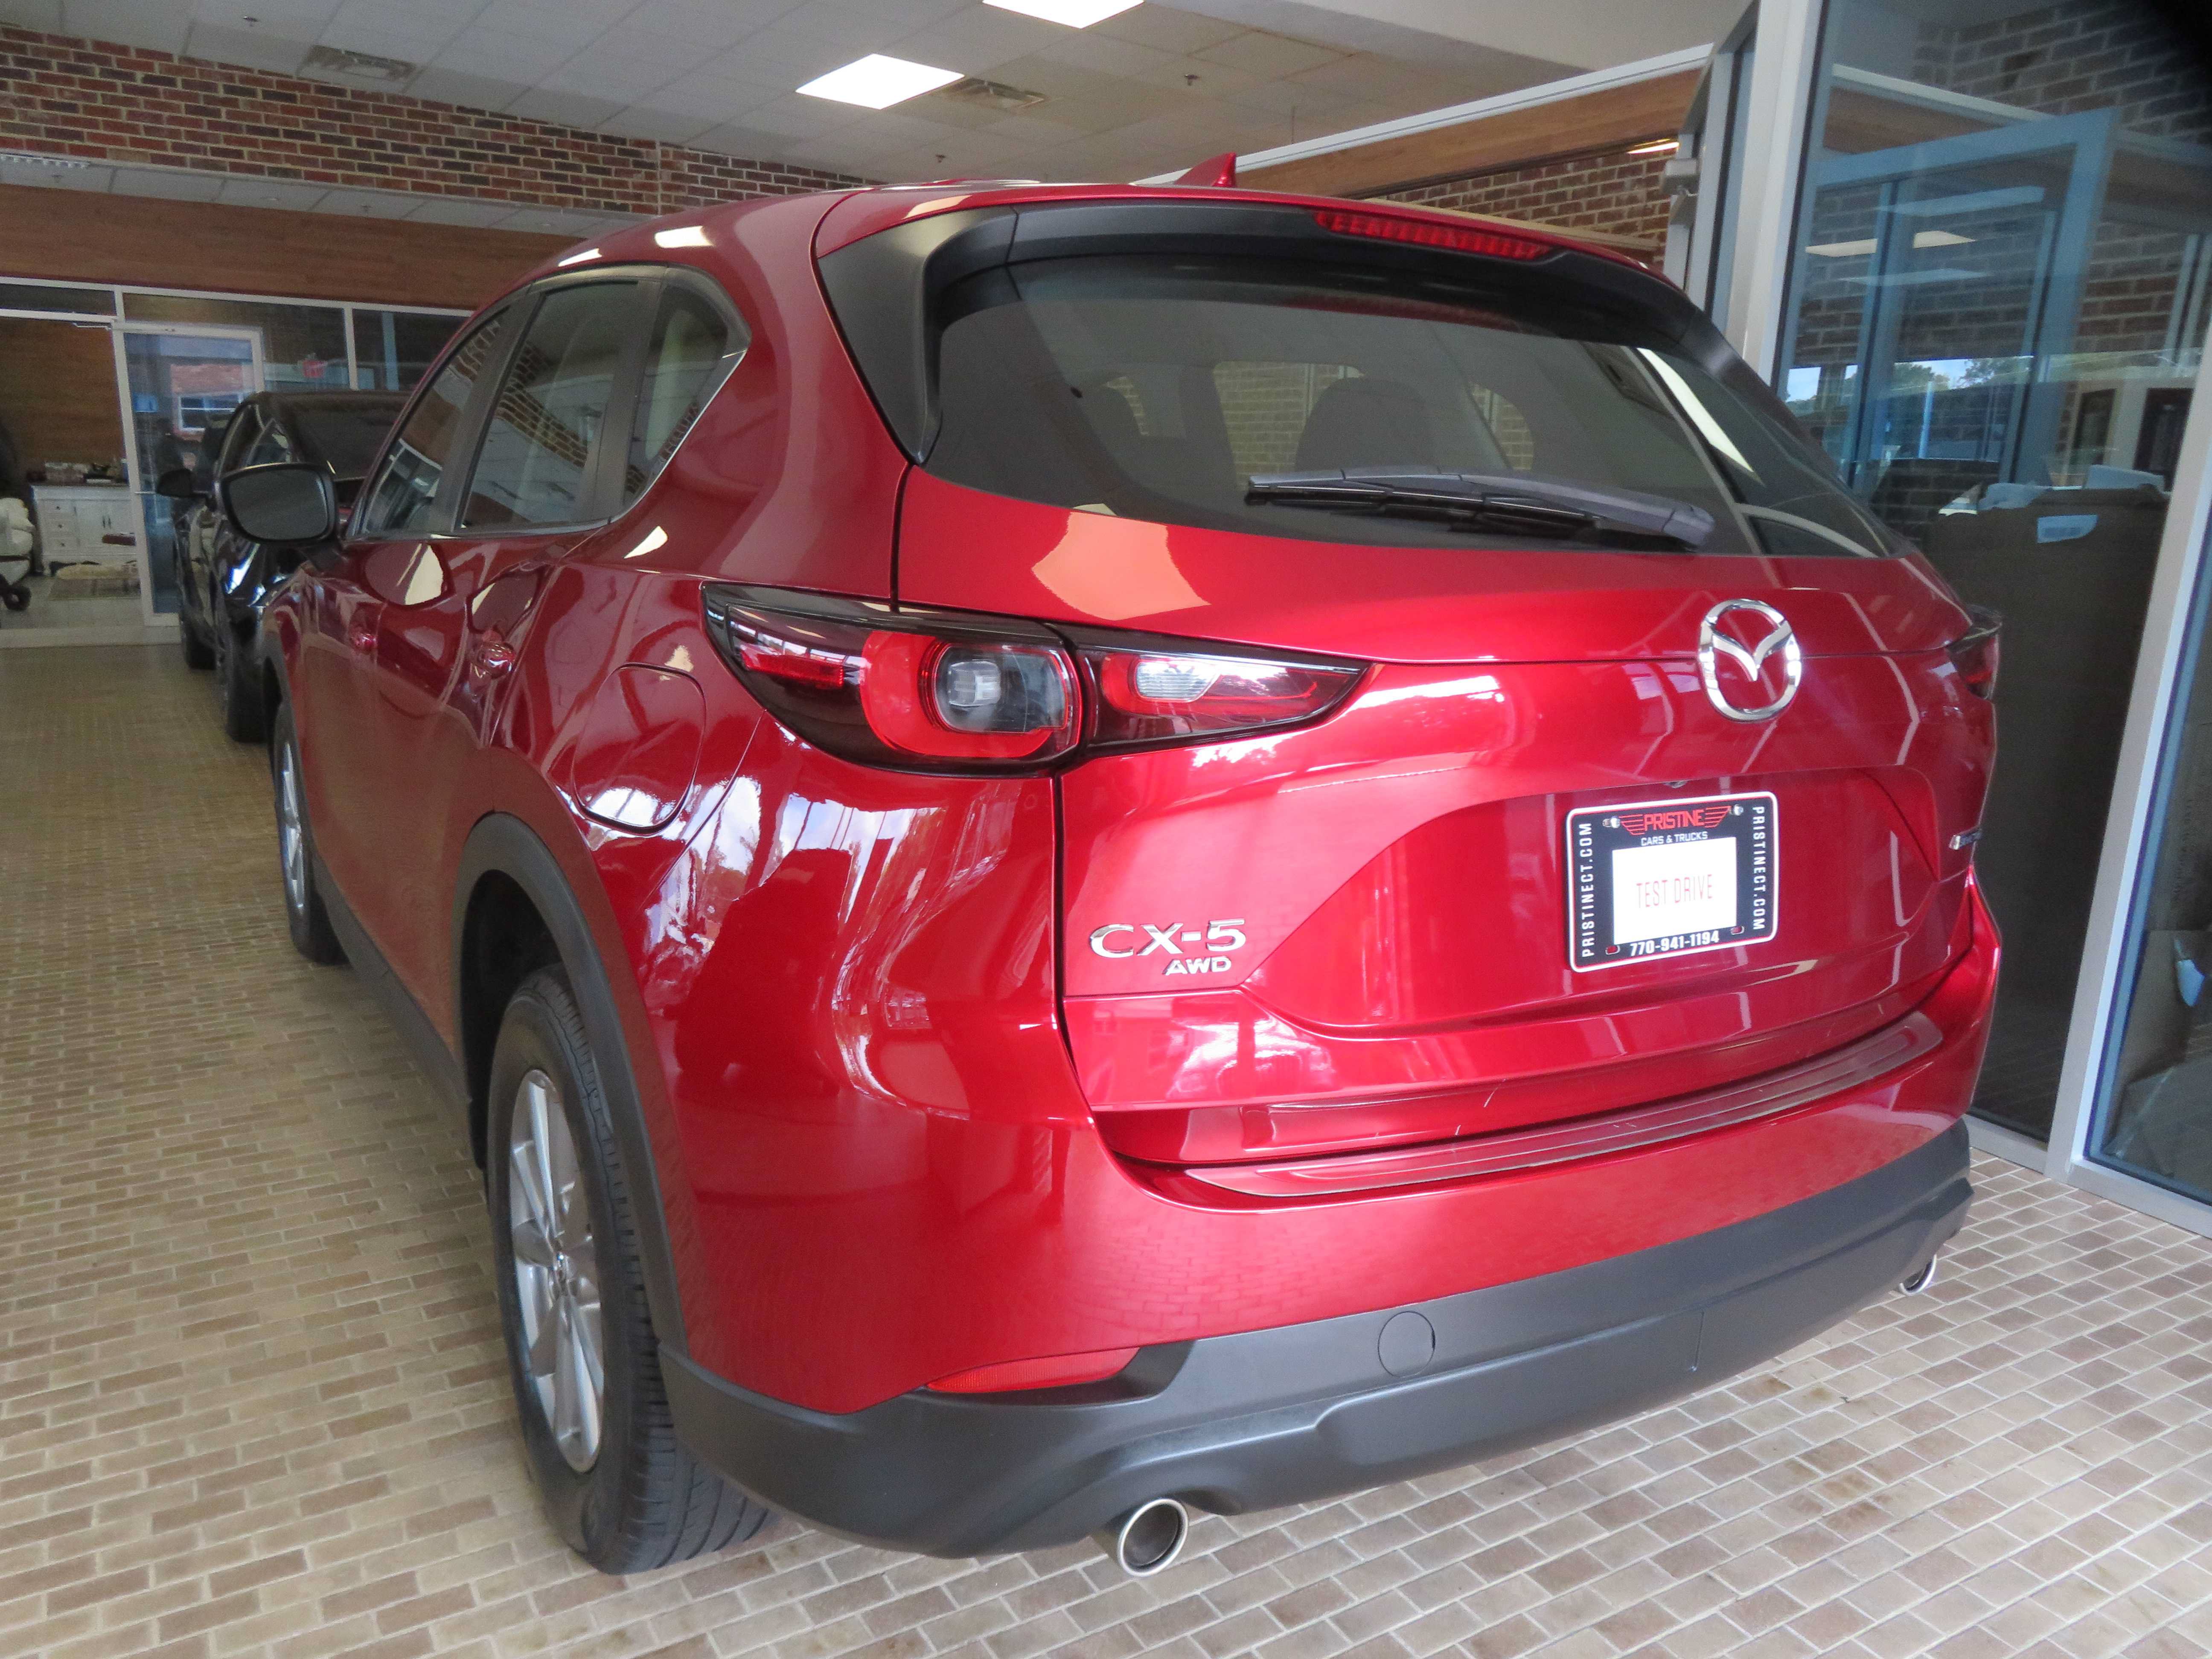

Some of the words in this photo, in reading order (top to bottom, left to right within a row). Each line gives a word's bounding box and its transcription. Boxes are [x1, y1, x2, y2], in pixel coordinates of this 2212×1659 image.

[1643, 809, 1705, 831] PRISTINE
[1641, 835, 1664, 847] CARS
[1666, 834, 1673, 844] &
[1674, 831, 1708, 843] TRUCKS
[1752, 806, 1766, 930] PRISTINECT.COM
[1579, 823, 1595, 958] PRISTINECT.COM
[1636, 879, 1668, 908] TEST
[1674, 874, 1713, 903] DRIVE
[1089, 918, 1246, 958] CX-5
[1630, 930, 1720, 957] 770-941-1194
[1161, 955, 1232, 976] AWD
